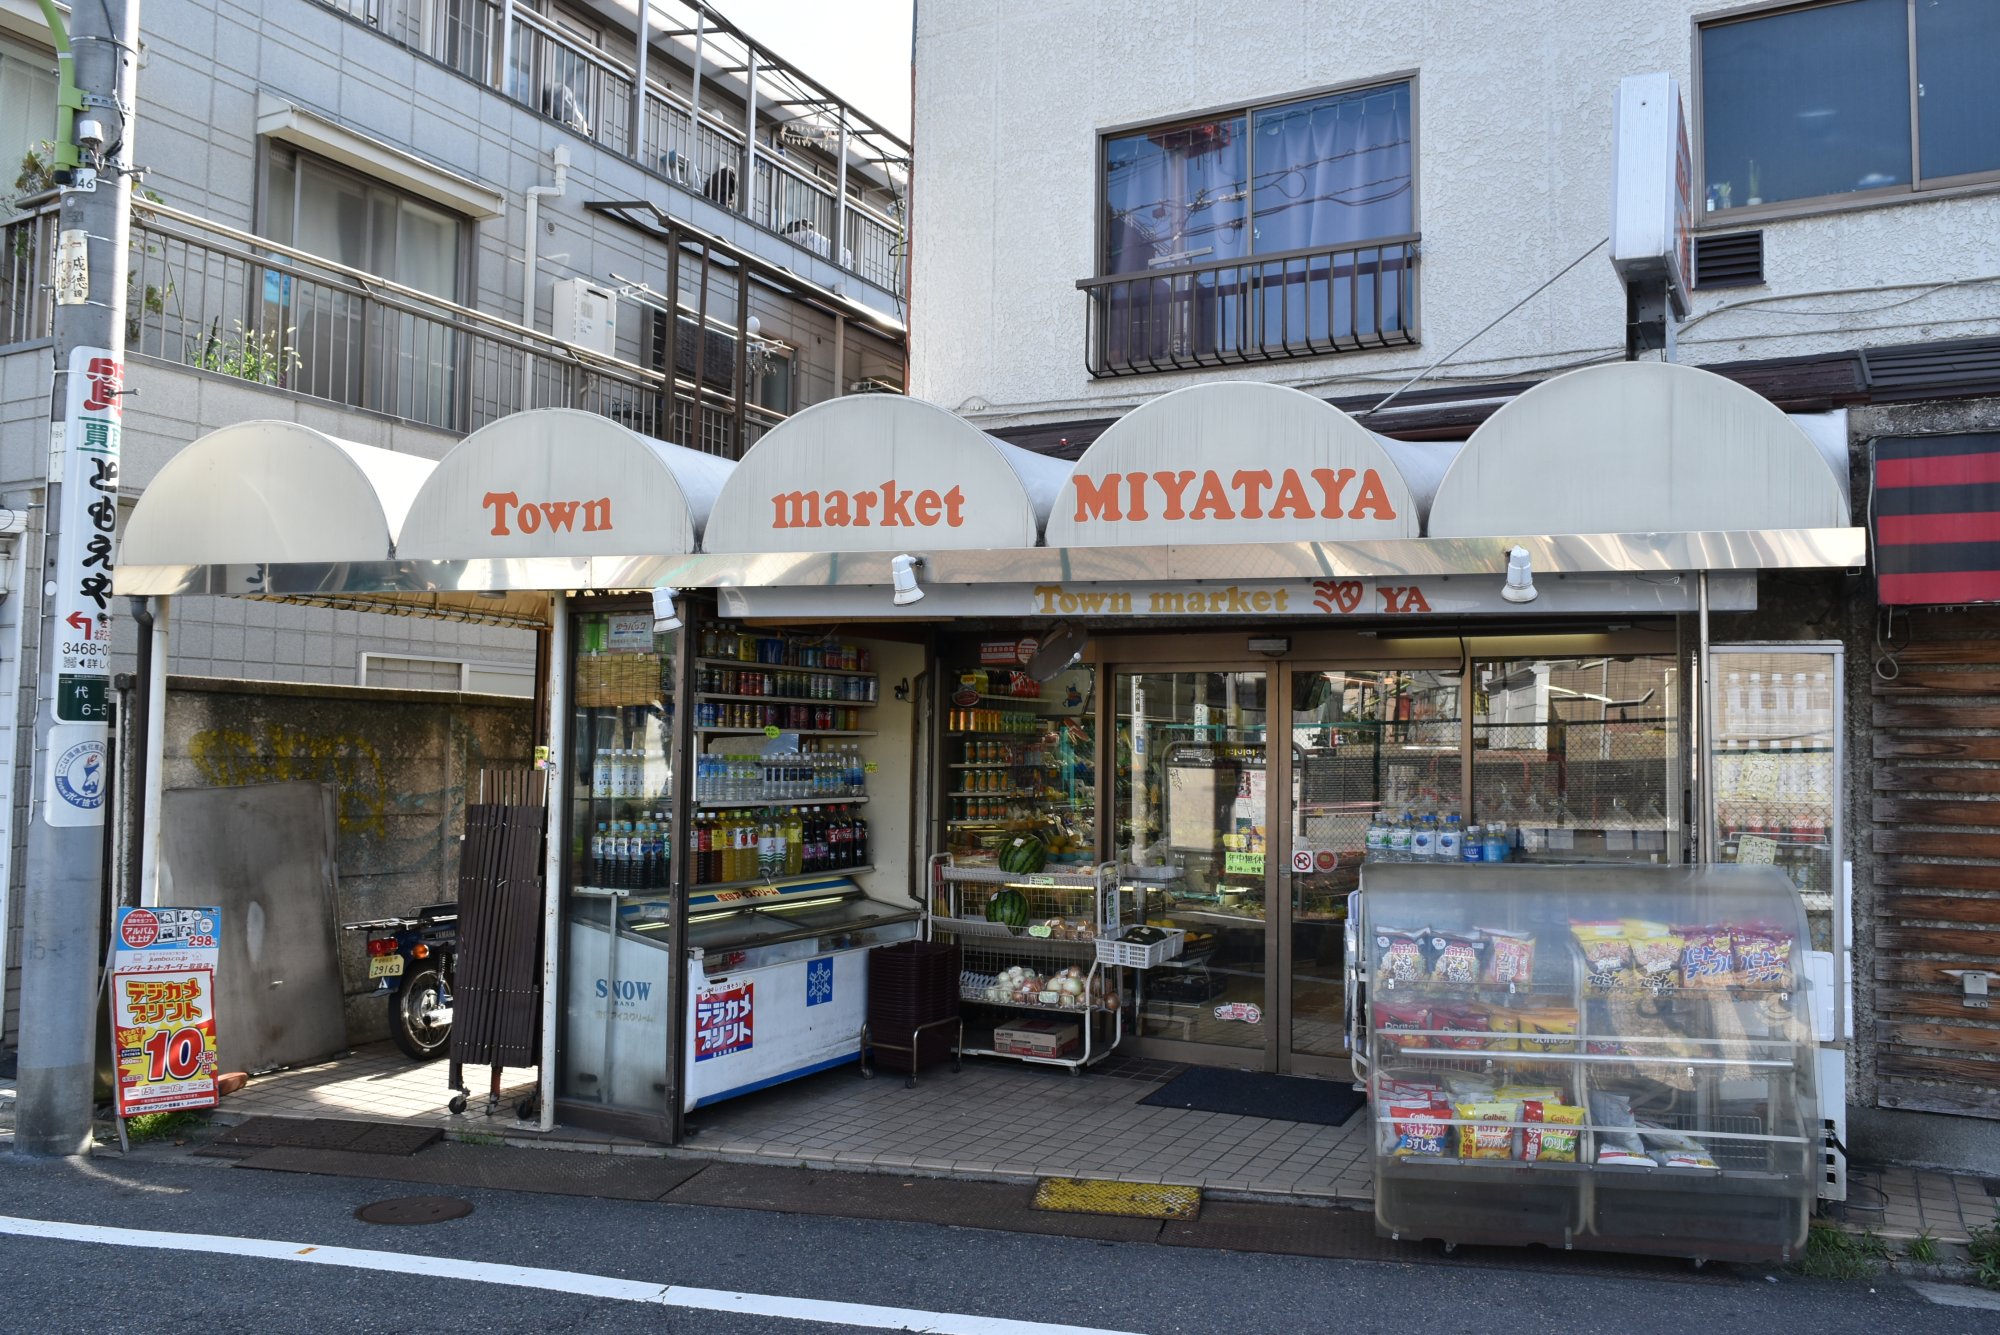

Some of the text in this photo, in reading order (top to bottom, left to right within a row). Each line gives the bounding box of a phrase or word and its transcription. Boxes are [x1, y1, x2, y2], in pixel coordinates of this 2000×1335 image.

[772, 479, 966, 529] market
[1073, 467, 1396, 522] MIYATAYA
[482, 491, 613, 536] Town
[80, 456, 120, 611] ともえや
[1034, 585, 1132, 614] Town
[1149, 586, 1290, 613] market
[62, 641, 110, 656] 3468-0
[1228, 853, 1264, 865] 年中無休
[125, 927, 154, 935] アルバム
[128, 935, 151, 944] 仕上げ
[188, 936, 212, 947] 298
[1747, 963, 1786, 984] チップ
[127, 979, 200, 1003] デジカメ
[595, 979, 652, 1001] SNOW
[128, 1002, 202, 1024] プリント
[698, 993, 752, 1027] デジカメ
[698, 1023, 752, 1052] プリント
[145, 1027, 204, 1081] 10
[1483, 1113, 1507, 1121] Calbee
[1551, 1114, 1575, 1123] Calbee
[1544, 1137, 1576, 1152] のりしお
